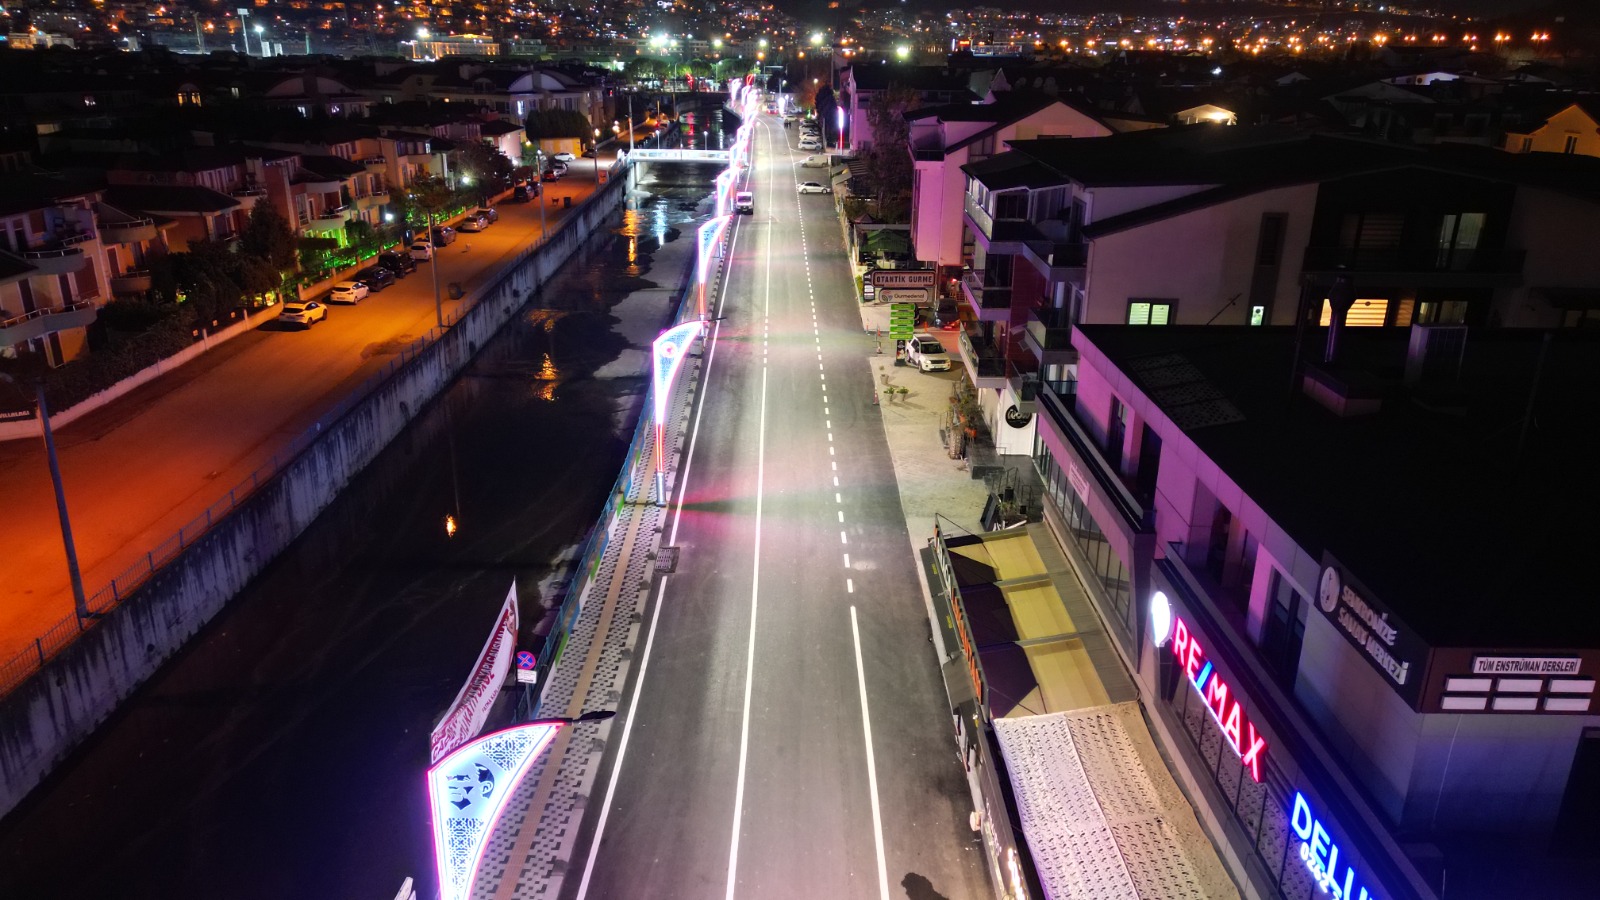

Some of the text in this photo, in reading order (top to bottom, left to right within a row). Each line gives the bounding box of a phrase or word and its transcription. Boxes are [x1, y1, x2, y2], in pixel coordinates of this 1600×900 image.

[876, 274, 933, 283] OTANTİK GURME
[1365, 635, 1409, 685] MERKEZİ
[1478, 658, 1578, 672] TÜM ENSTRÜMAN DERSLERİ
[1291, 791, 1373, 900] DELU
